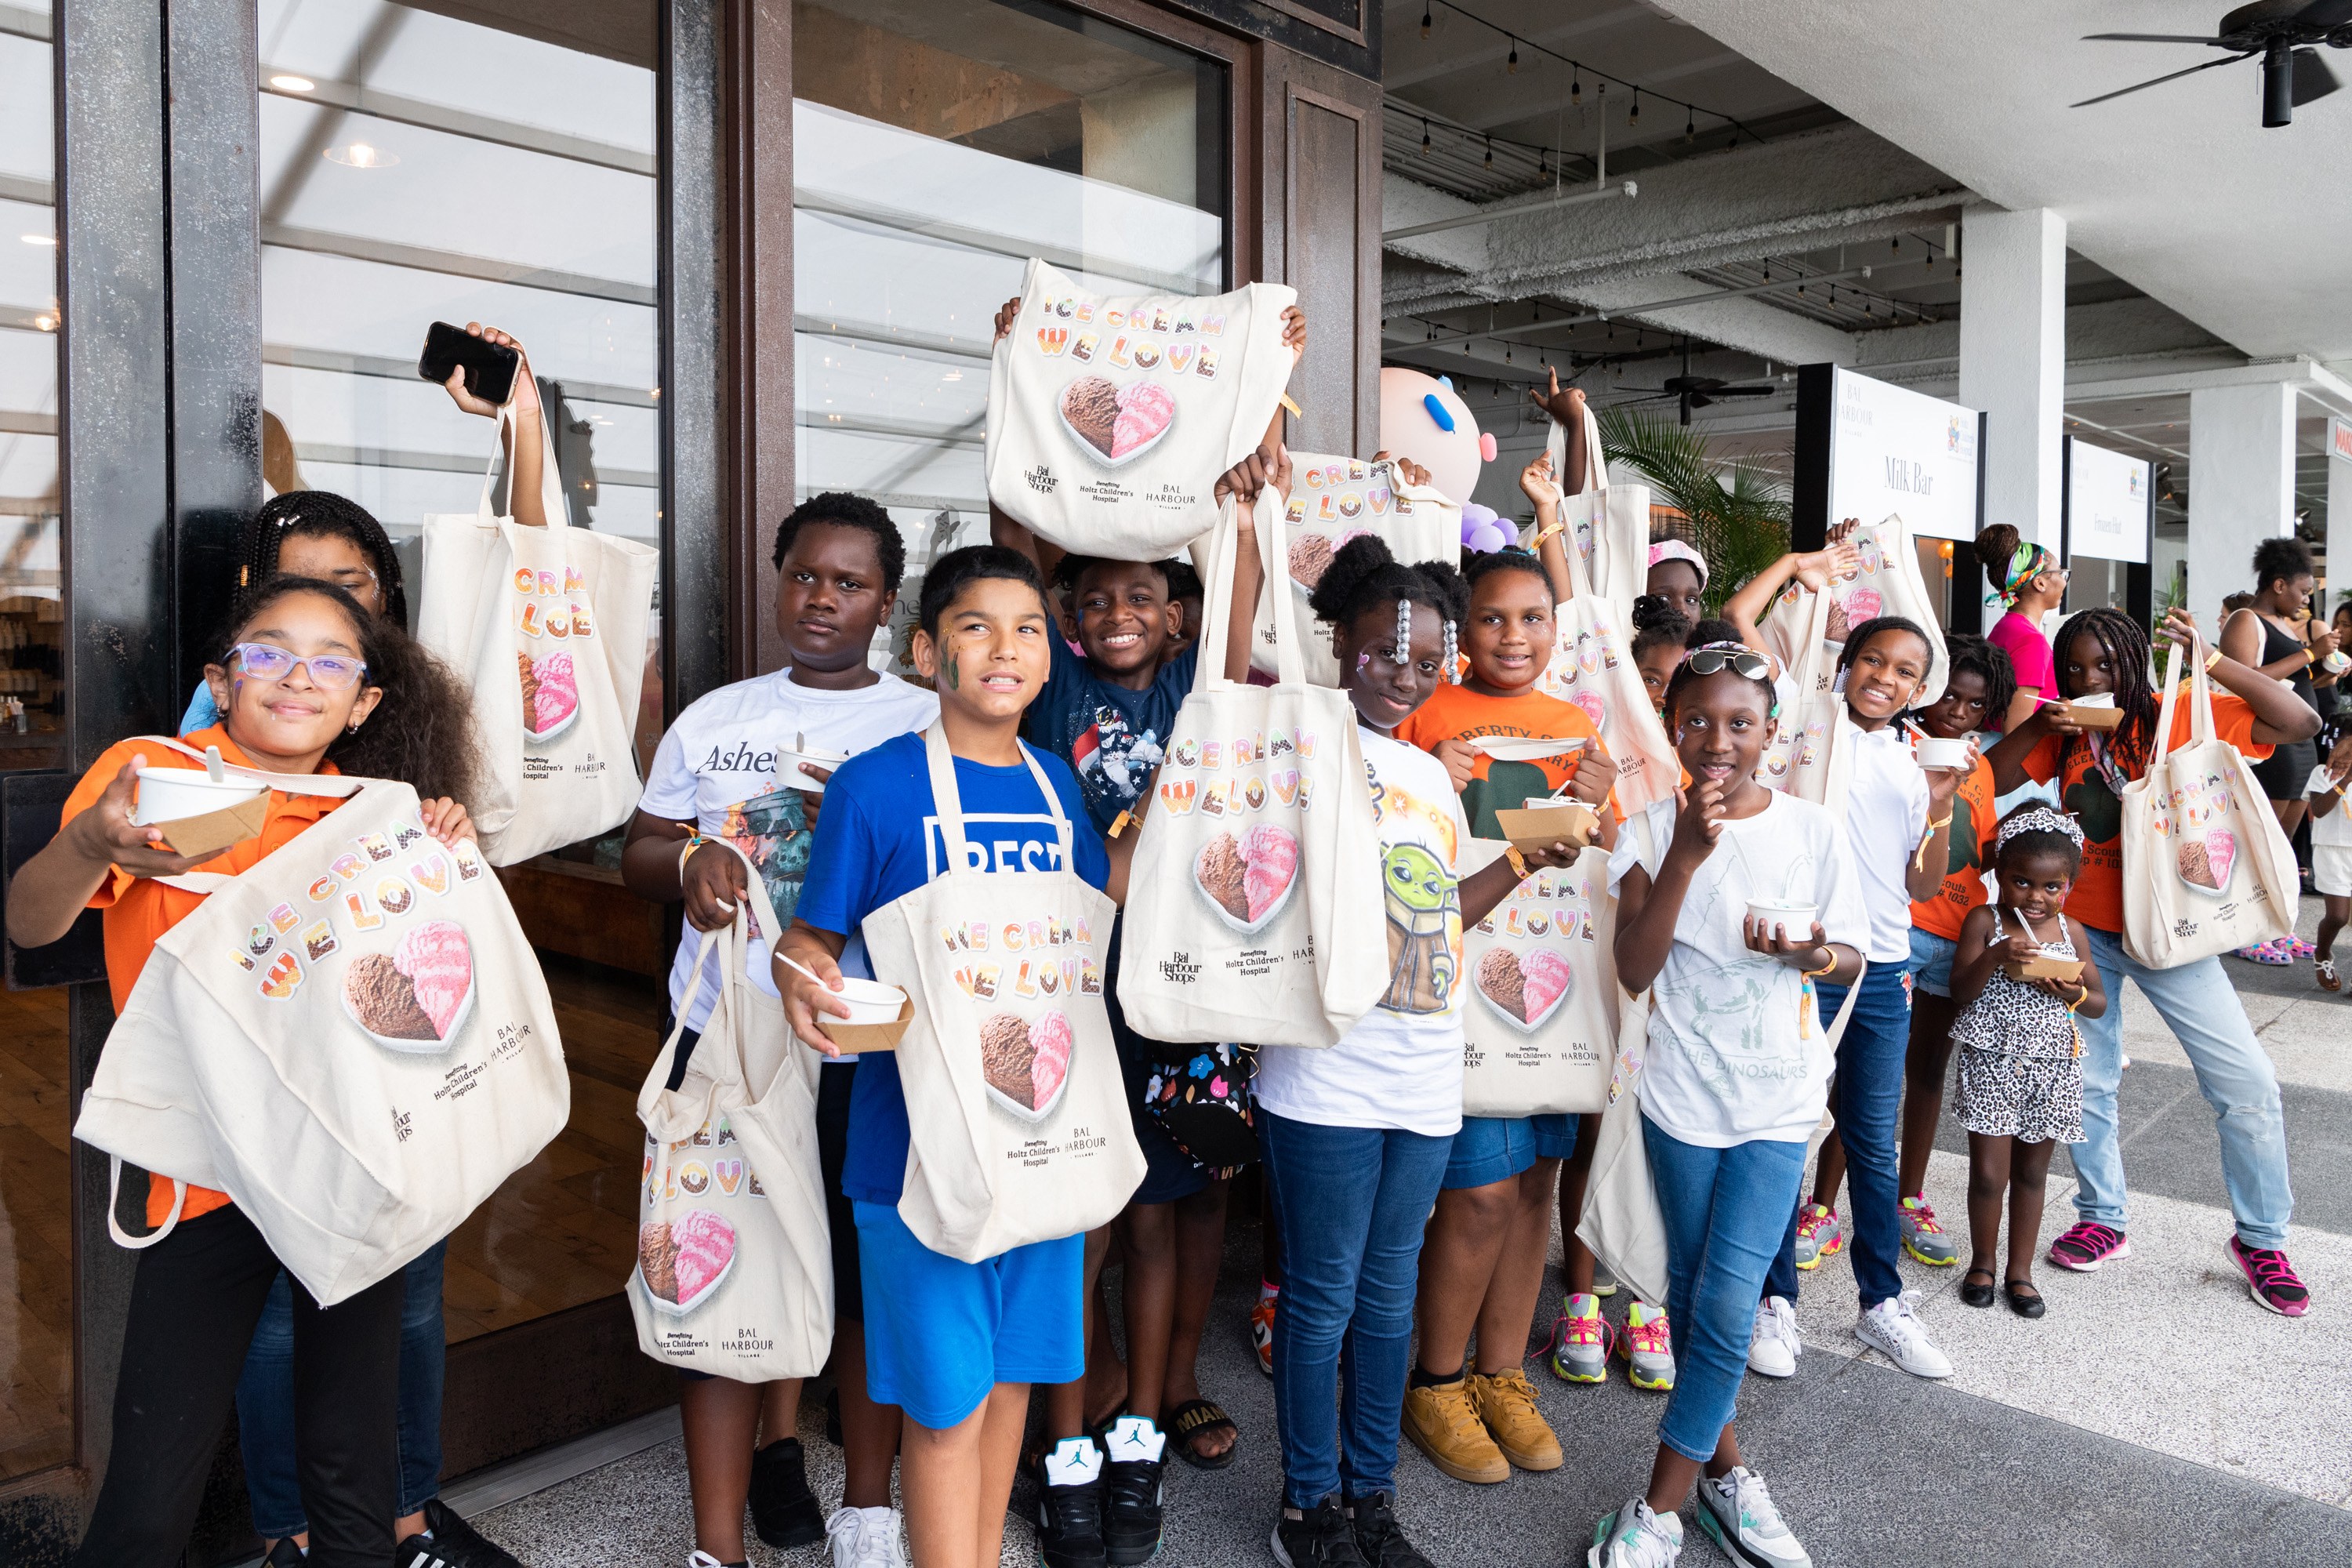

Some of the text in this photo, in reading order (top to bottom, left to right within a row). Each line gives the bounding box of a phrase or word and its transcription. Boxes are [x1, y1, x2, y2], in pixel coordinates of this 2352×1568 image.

[1044, 294, 1226, 337] ICE CREAM
[1036, 326, 1221, 381] WE LOVE
[1847, 383, 1861, 402] BAL
[1036, 465, 1049, 477] Bal
[1305, 457, 1389, 492] CREA
[1884, 456, 1933, 496] Milk Bar
[1024, 470, 1058, 487] Harbour
[1027, 479, 1053, 495] Shops
[1080, 485, 1134, 497] Holtz Children's
[1163, 484, 1181, 494] BAL
[1092, 495, 1120, 504] Hospital
[1145, 493, 1196, 505] HARBOUR
[1544, 646, 1621, 693] LOVE
[1618, 757, 1646, 775] ARBOUR
[1621, 755, 1635, 765] BAL
[1159, 777, 1229, 819] WE
[2087, 844, 2122, 858] Scout
[1947, 891, 1969, 906] 1032
[257, 844, 482, 1001] WE LOVE
[2177, 917, 2188, 926] Bal
[227, 902, 302, 973] ICE
[2176, 930, 2197, 938] Shops
[1174, 951, 1189, 964] Bal
[1240, 949, 1267, 958] Benefiting
[1160, 960, 1202, 974] Harbour
[1225, 955, 1284, 968] Holtz Children's
[1014, 951, 1102, 1000] LOVE
[1164, 971, 1196, 985] Shops
[1240, 965, 1270, 977] Hospital
[490, 1025, 531, 1062] HARBOUR
[1561, 1052, 1600, 1062] HARBOUR
[450, 1062, 488, 1088] Children's
[1714, 1060, 1808, 1080] DINOSAURS
[450, 1079, 477, 1102] Hospital
[1073, 1127, 1091, 1138] BAL
[1065, 1137, 1106, 1152] HARBOUR
[1007, 1145, 1060, 1160] Holtz Children's
[1023, 1156, 1049, 1167] Hospital
[739, 1327, 757, 1339] BAL
[672, 1340, 710, 1348] Children's
[722, 1340, 774, 1351] HARBOUR
[666, 1348, 695, 1357] Hospital
[1177, 1406, 1229, 1434] MIAM
[1283, 1508, 1303, 1521] PUMA
